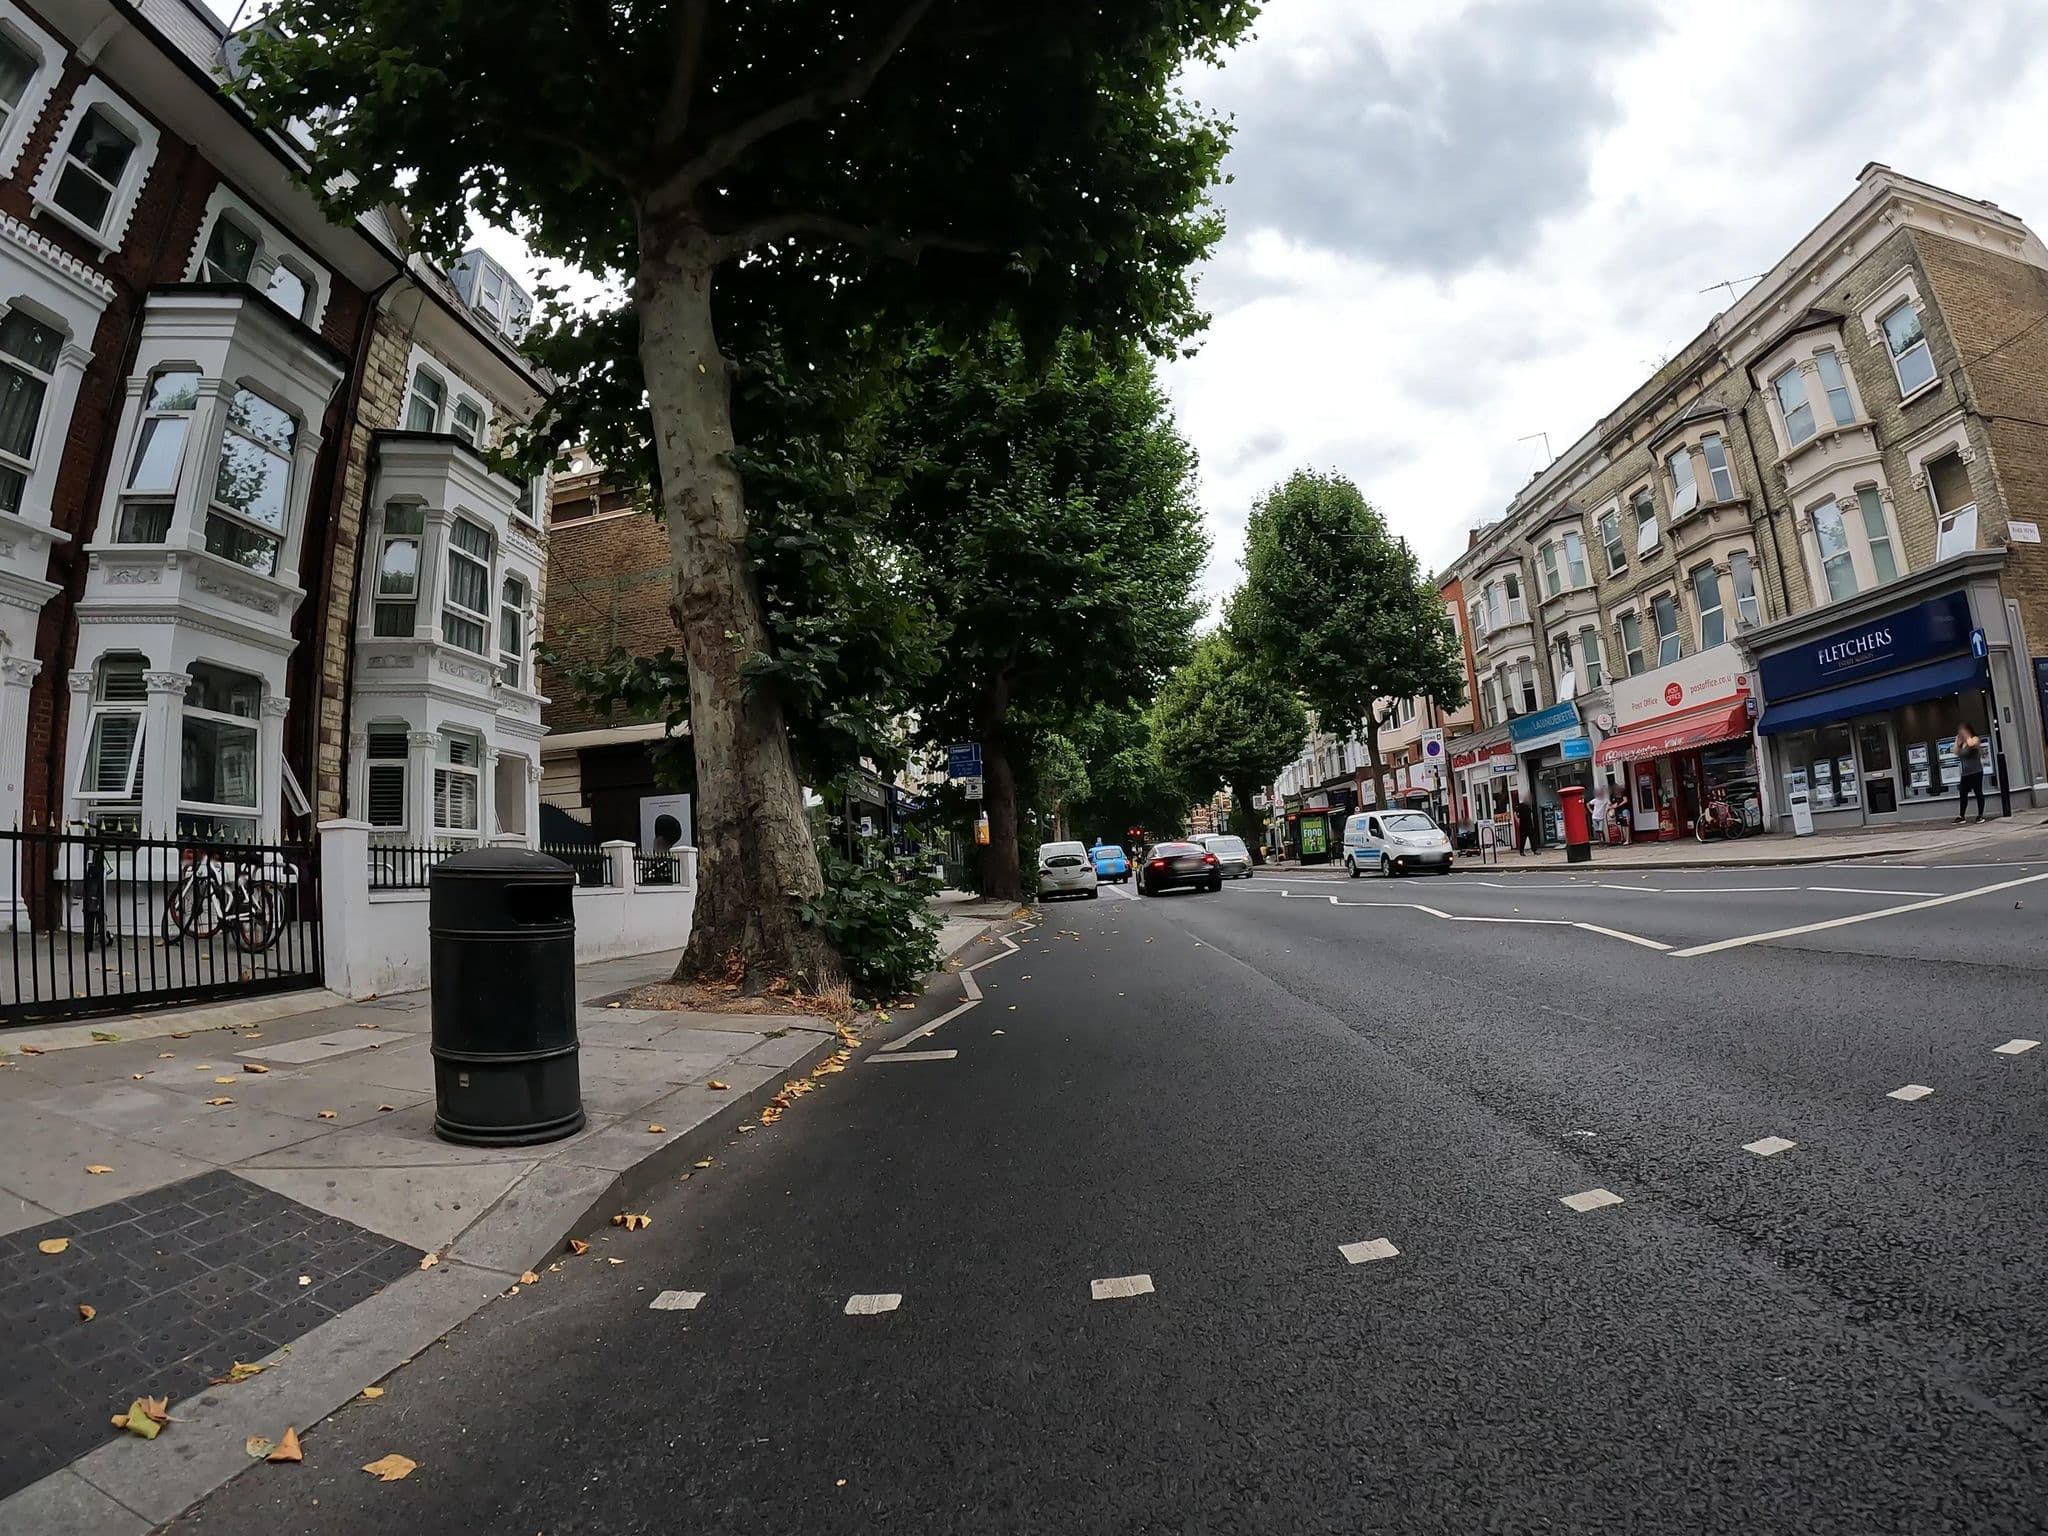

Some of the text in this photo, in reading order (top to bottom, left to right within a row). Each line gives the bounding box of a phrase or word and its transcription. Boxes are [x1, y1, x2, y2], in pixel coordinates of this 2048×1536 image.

[1818, 628, 1892, 665] FLETCHERS
[1631, 697, 1658, 711] Post Office
[1532, 710, 1576, 730] LAUNDERETTE
[1303, 828, 1323, 838] FOOD
